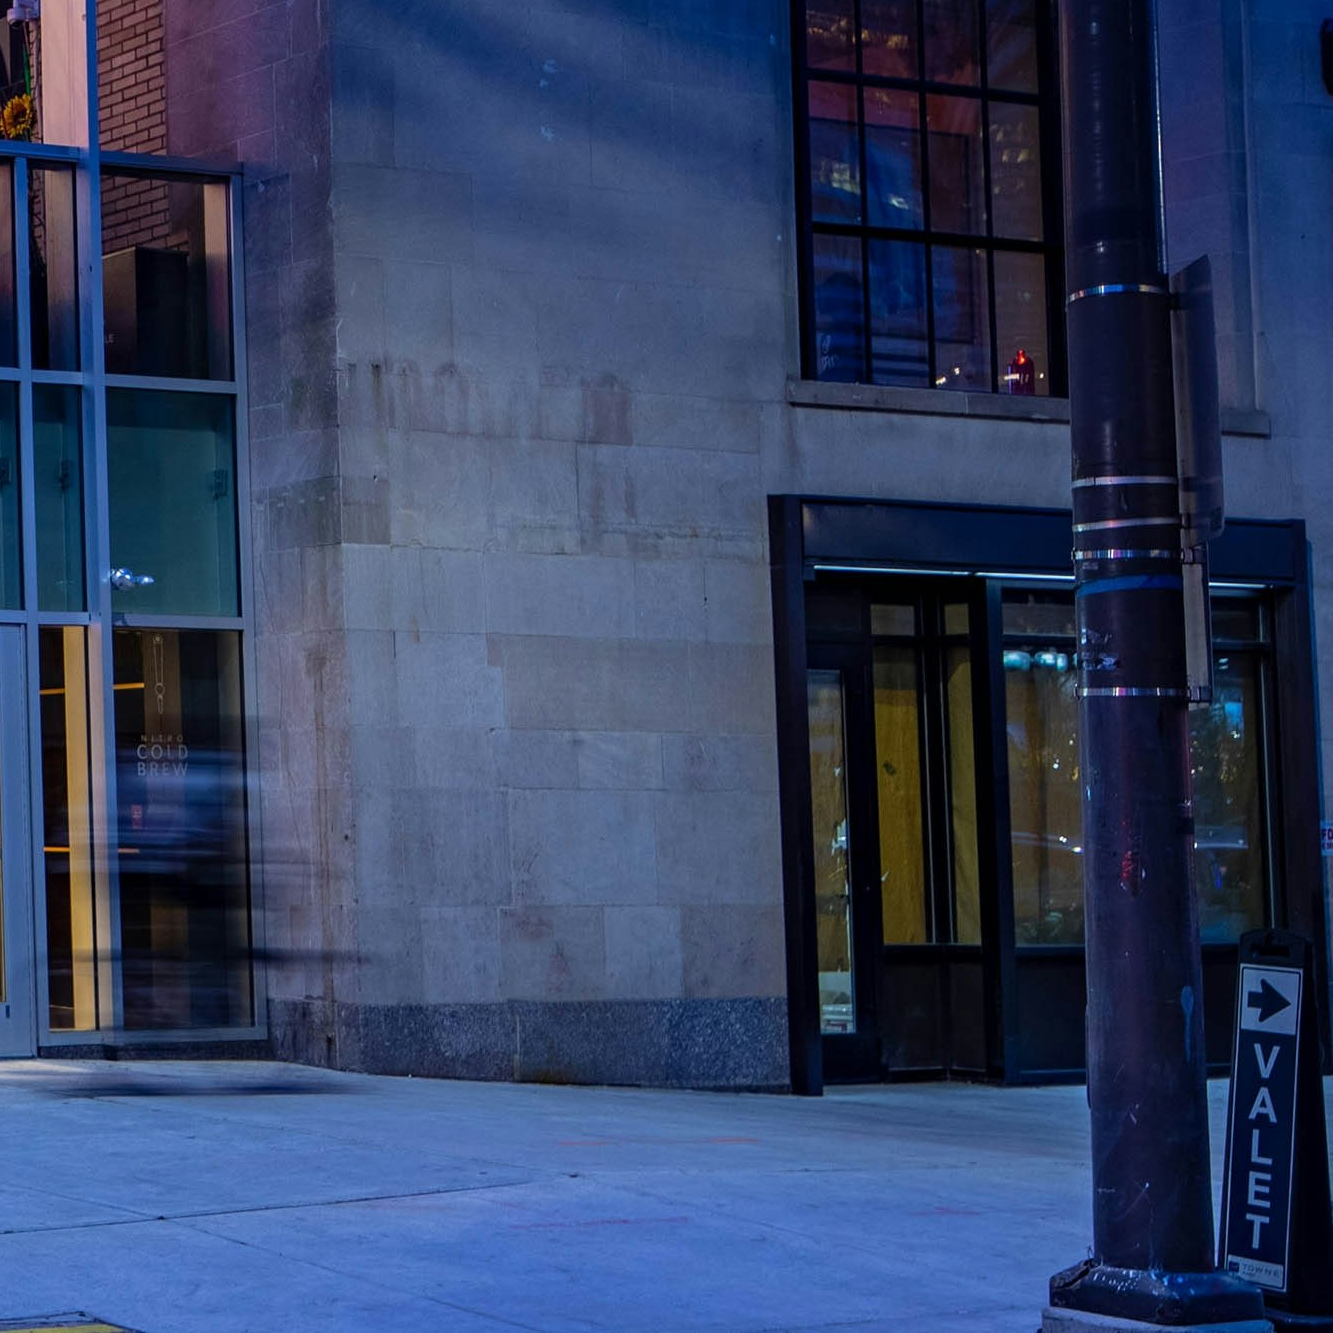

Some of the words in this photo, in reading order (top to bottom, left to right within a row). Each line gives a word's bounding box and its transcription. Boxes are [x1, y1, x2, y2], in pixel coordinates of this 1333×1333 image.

[136, 743, 188, 759] COLD
[137, 762, 188, 776] BREW
[1244, 1042, 1280, 1250] VALET
